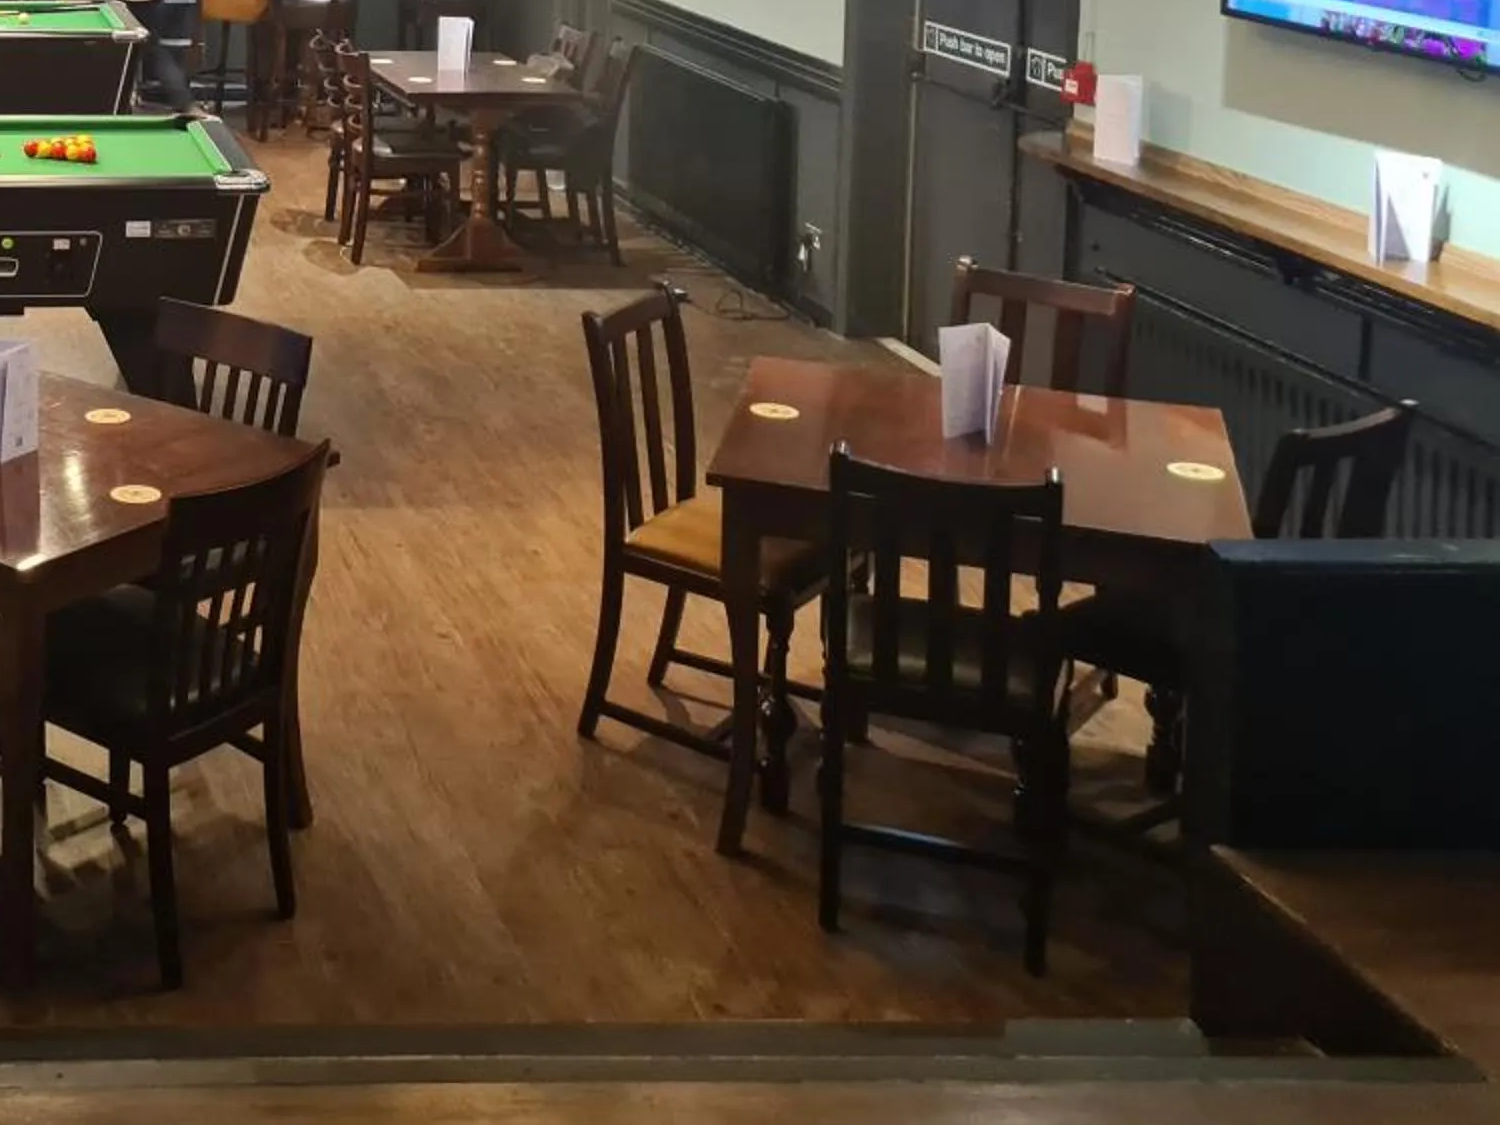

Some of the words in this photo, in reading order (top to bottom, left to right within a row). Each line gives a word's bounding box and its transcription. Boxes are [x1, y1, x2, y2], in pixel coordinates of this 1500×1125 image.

[939, 32, 959, 49] Push
[960, 35, 973, 54] bar
[984, 48, 1005, 65] open
